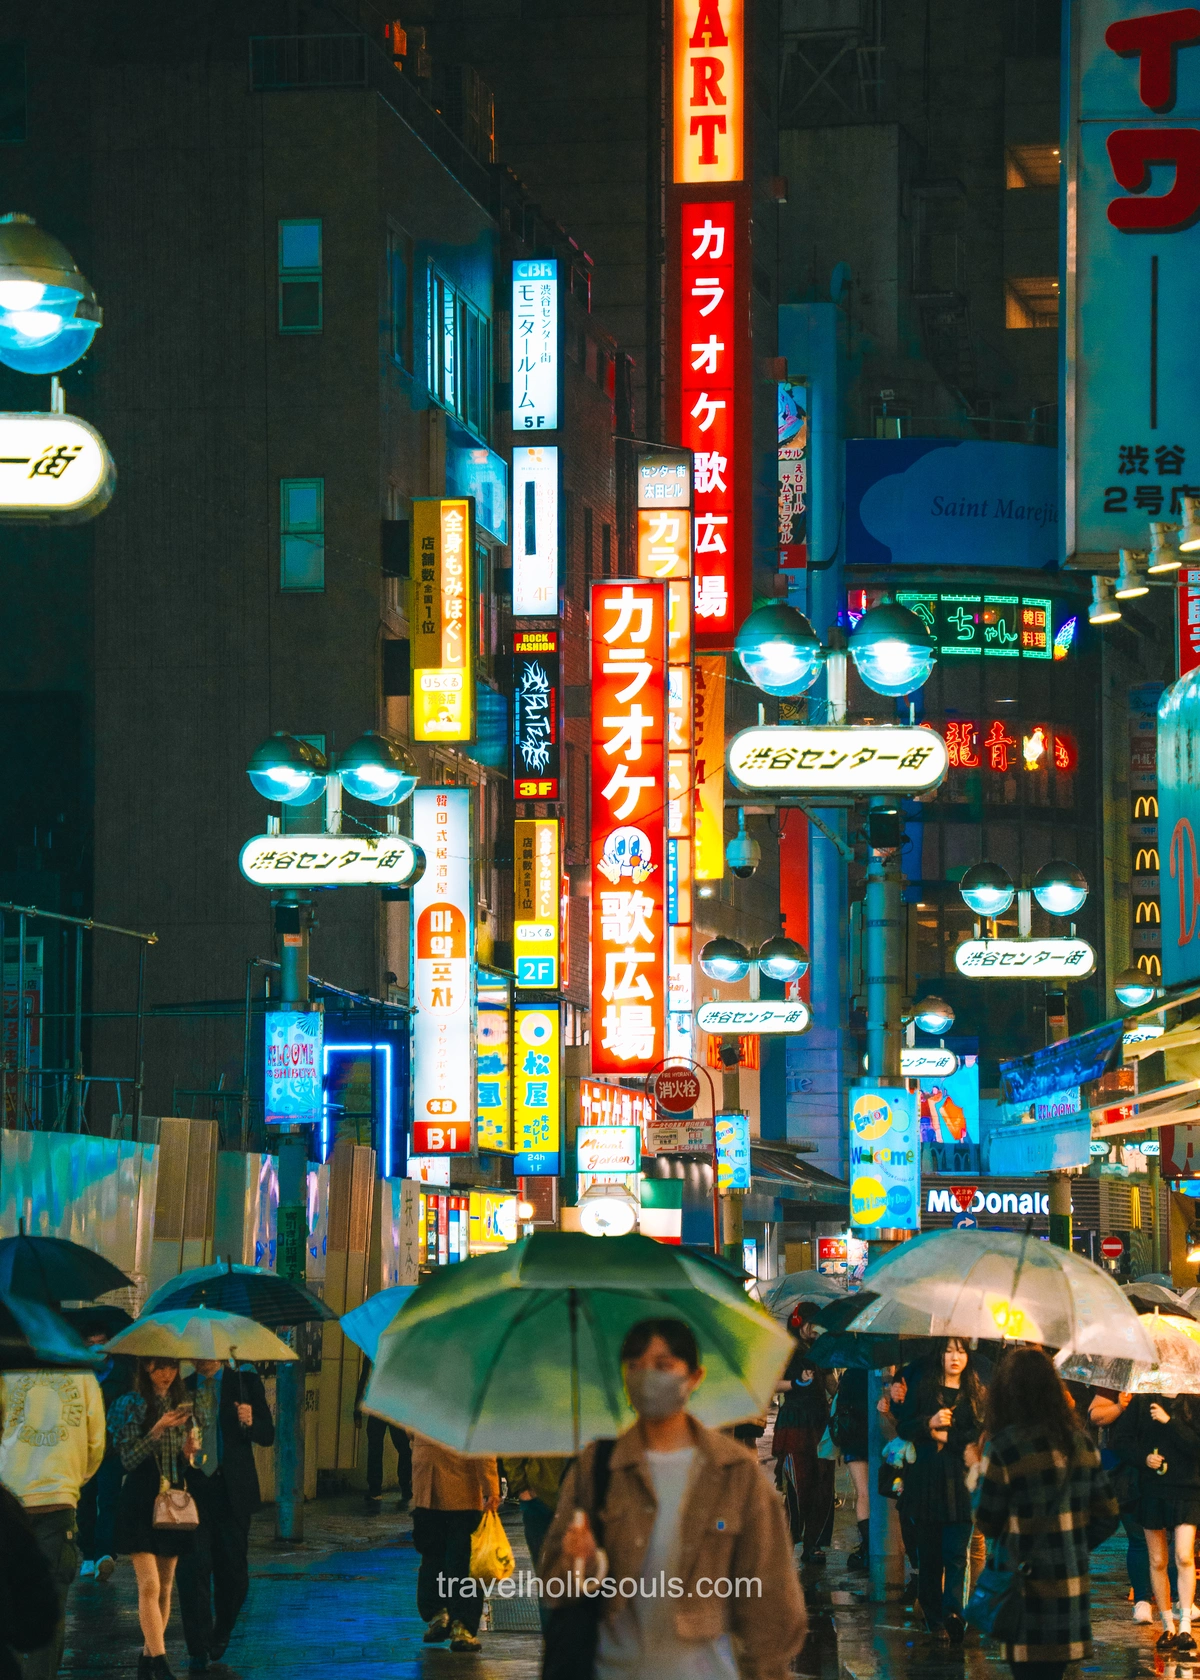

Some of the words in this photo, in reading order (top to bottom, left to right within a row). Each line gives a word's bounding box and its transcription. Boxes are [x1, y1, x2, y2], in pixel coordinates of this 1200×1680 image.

[517, 263, 553, 277] CBR
[540, 284, 551, 363] 渋谷センター街
[518, 285, 536, 409] モニタールーム
[1118, 444, 1186, 475] 渋谷
[641, 465, 686, 478] センター街
[644, 483, 683, 498] 太田ビル
[931, 496, 989, 518] Saint
[444, 510, 463, 663] 全身もみほぐし
[1023, 610, 1046, 627] 韓国
[516, 643, 555, 652] FASHION
[523, 634, 548, 643] ROCK
[1023, 631, 1046, 647] 料理
[423, 677, 459, 689] りらくる
[601, 587, 656, 821] カラオケ
[739, 747, 935, 770] 渋谷センター街
[519, 782, 552, 796] 3F
[250, 850, 405, 869] 渋谷センター街
[539, 828, 552, 918] 全身もみほぐし
[430, 911, 453, 1007] 마약포차
[963, 951, 1086, 966] 渋谷センター街
[523, 963, 550, 980] 2F
[600, 890, 656, 1060] 歌広場
[702, 1010, 802, 1024] 渋谷センター街
[523, 1051, 550, 1107] 松屋
[659, 1079, 698, 1099] 消火栓
[854, 1106, 889, 1133] Enjoy
[427, 1128, 457, 1149] B1
[851, 1146, 914, 1165] Welcome
